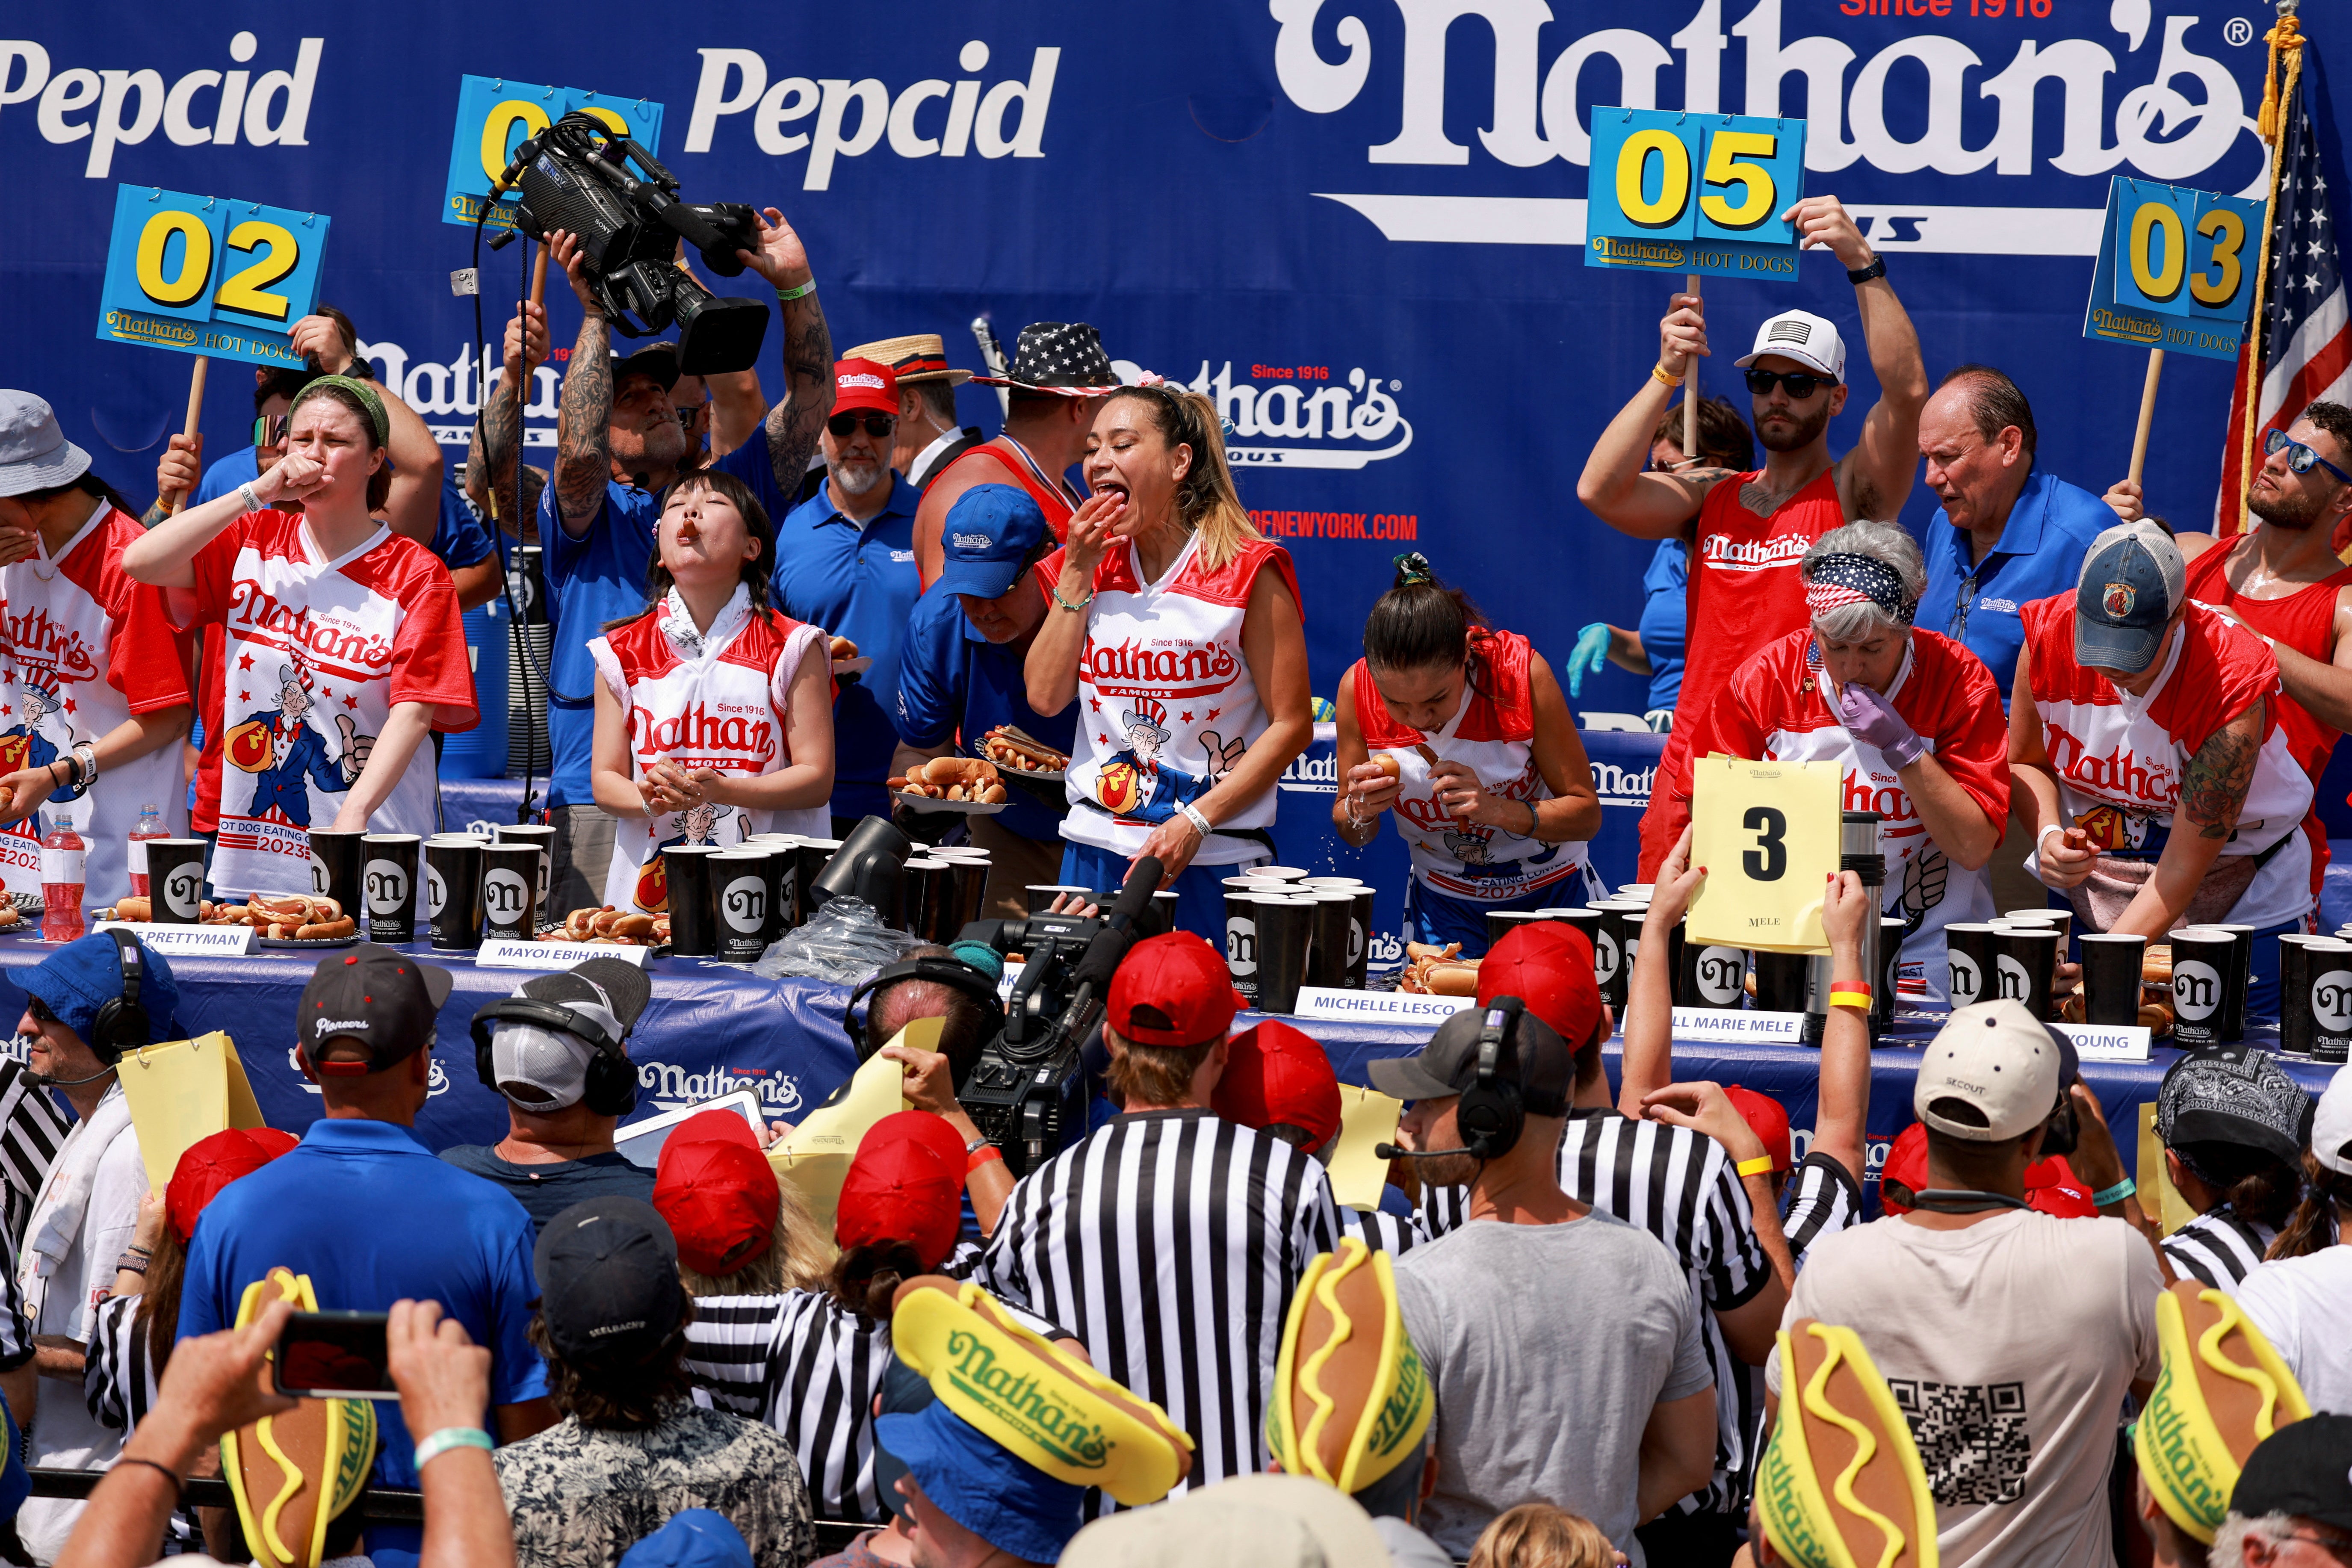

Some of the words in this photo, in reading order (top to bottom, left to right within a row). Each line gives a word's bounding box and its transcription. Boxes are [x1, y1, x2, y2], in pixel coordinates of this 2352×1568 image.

[0, 31, 324, 178] Pepcid
[684, 40, 1061, 191] Pepcid
[545, 162, 567, 185] TNDV
[1616, 129, 1776, 230] 05
[595, 218, 611, 234] SONY
[1593, 237, 1686, 265] Nathan's
[1692, 251, 1731, 268] HOT
[1740, 255, 1794, 273] DOGS
[2130, 201, 2245, 309] 03
[136, 210, 301, 322] 02
[106, 311, 198, 345] Nathan's
[204, 334, 245, 352] HOT
[251, 340, 304, 362] DOGS
[2093, 308, 2162, 341] Nathan's
[2168, 328, 2197, 343] HOT
[2199, 335, 2236, 353] DOGS
[1251, 364, 1294, 379] Since
[1297, 366, 1329, 380] 1916
[953, 532, 991, 545] Nathan's
[1703, 532, 1811, 561] Nathan's
[1776, 534, 1788, 543] 1916
[1735, 562, 1772, 571] FAMOUS
[1981, 597, 2016, 610] Nathan's
[319, 613, 340, 626] Since
[342, 620, 361, 633] 1916
[6, 606, 92, 670] athn's
[1150, 638, 1171, 647] Since
[16, 657, 57, 668] AMOU
[1109, 688, 1173, 698] FAMOUS
[717, 703, 742, 713] Since
[744, 706, 765, 716] 1916
[633, 700, 775, 757] Nathan
[674, 758, 740, 768] AMOUS
[2145, 754, 2164, 771] Since
[1749, 769, 1782, 778] Nathan's
[1870, 771, 1897, 783] Since
[238, 822, 261, 833] DOG
[264, 826, 302, 841] EATING
[13, 839, 39, 855] EATING
[259, 836, 305, 856] 2023
[1743, 806, 1787, 881] 3
[1481, 875, 1524, 888] EATING
[1476, 883, 1530, 899] 2023
[370, 918, 401, 929] Nathan's
[1749, 918, 1781, 927] MELE
[146, 931, 240, 945] PRETTYMAN
[489, 929, 520, 939] Nathan's
[498, 947, 549, 959] MAYOI
[1314, 996, 1399, 1013] MICHELLE
[1403, 1002, 1455, 1016] LESCO
[315, 1017, 369, 1039] Pioneers
[1694, 1016, 1745, 1031] MARIE
[1750, 1019, 1794, 1034] MELE
[2175, 1023, 2211, 1035] Nathan's
[2070, 1034, 2129, 1049] YOUNG
[2318, 1036, 2352, 1046] Nathan
[1866, 1132, 1887, 1140] Since
[946, 1329, 1107, 1468] Nathan's
